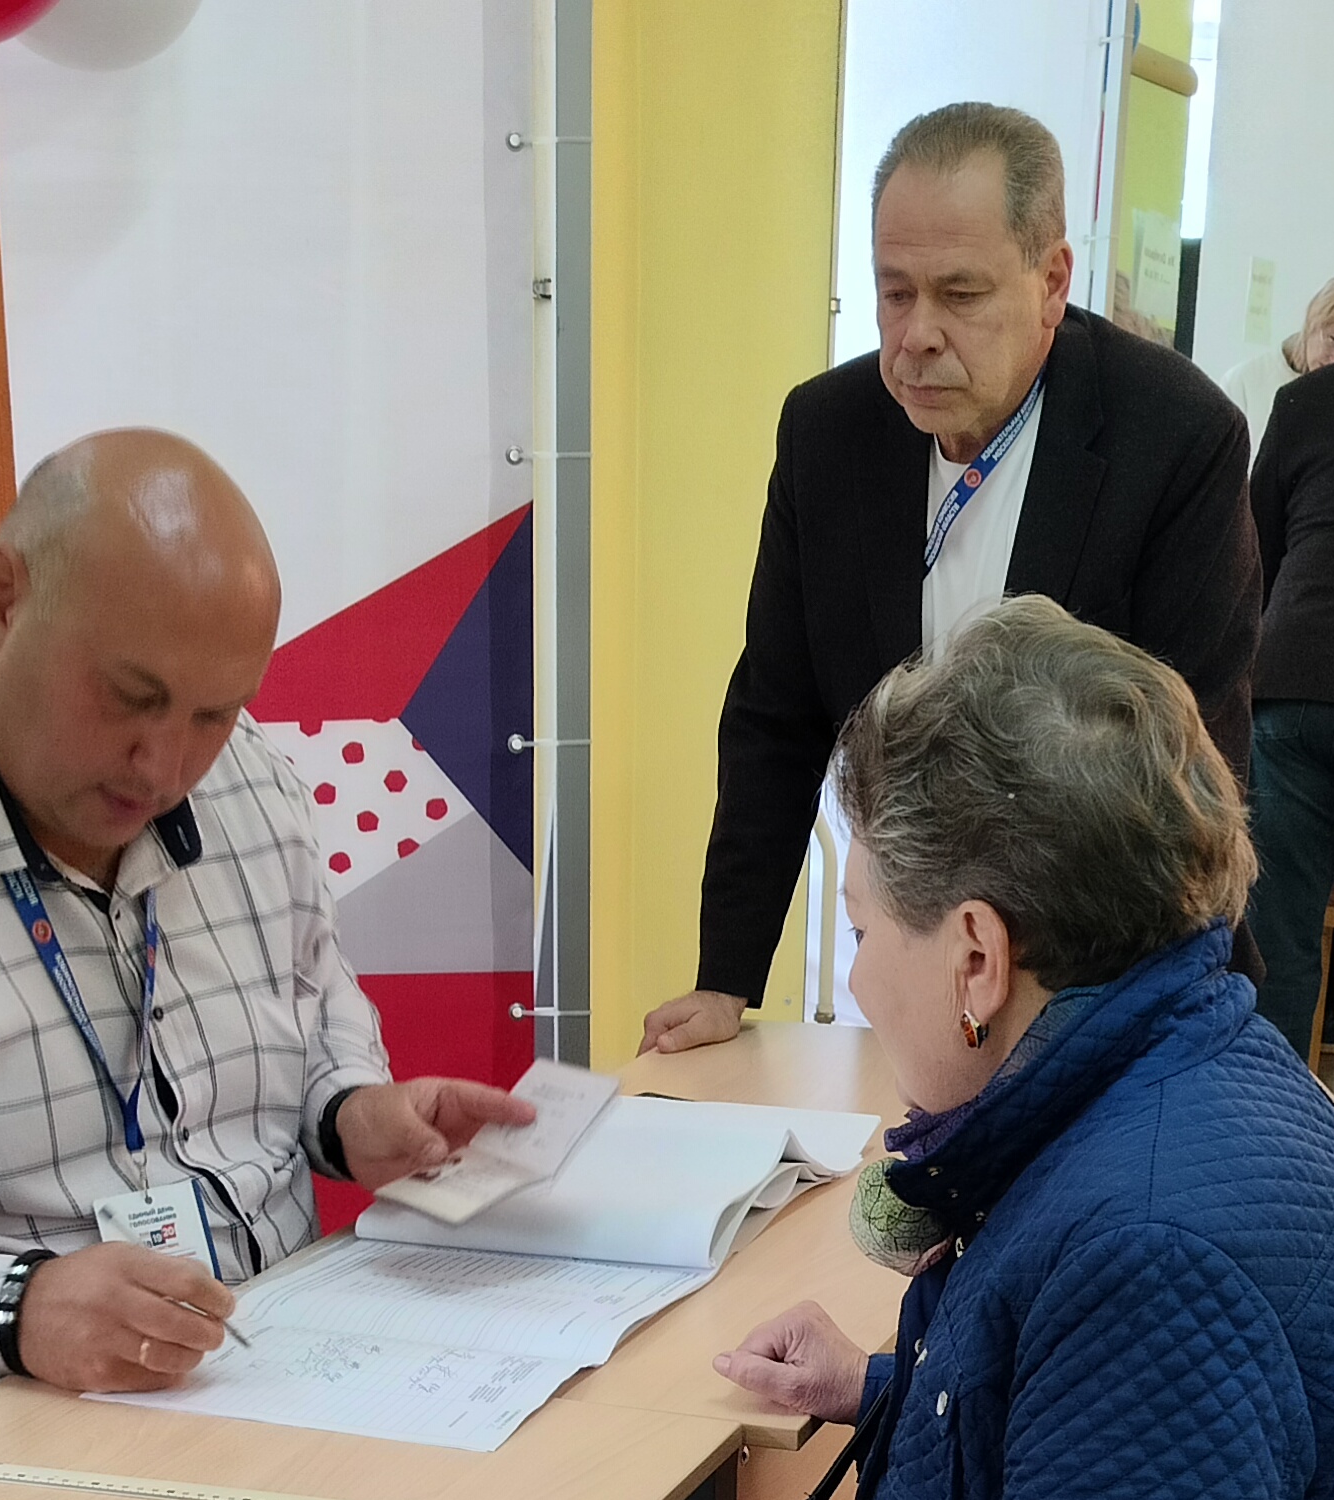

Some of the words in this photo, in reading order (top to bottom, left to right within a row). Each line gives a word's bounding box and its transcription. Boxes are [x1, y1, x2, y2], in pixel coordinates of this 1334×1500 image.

[992, 419, 1024, 462] МОСКОВСКОЙ
[936, 489, 959, 524] КОМИССИЯ
[942, 502, 960, 533] ОБЛАСТИ
[162, 1226, 175, 1237] 20
